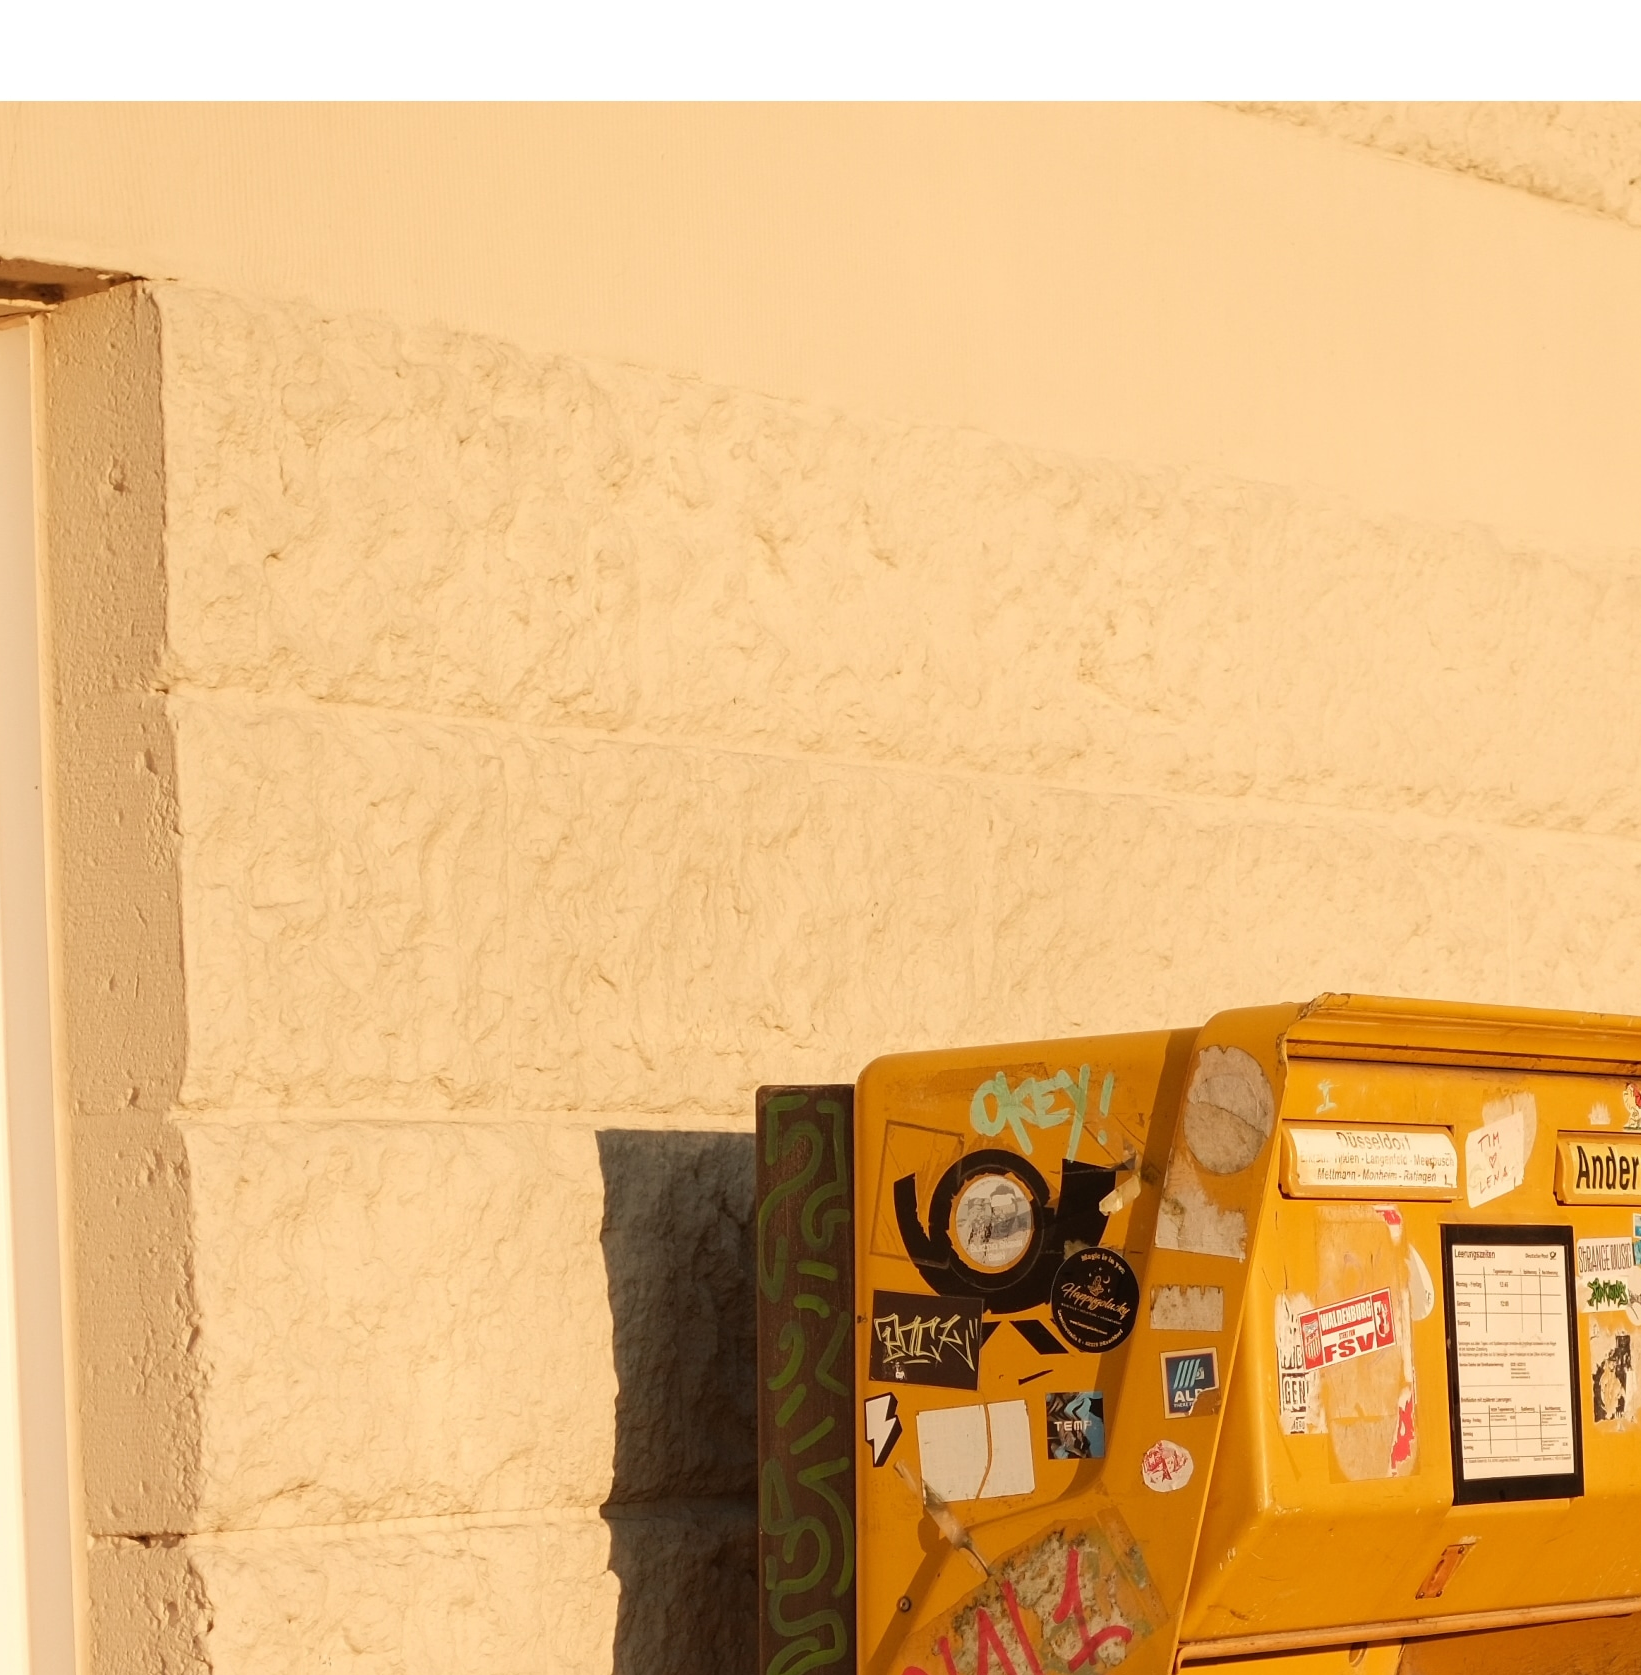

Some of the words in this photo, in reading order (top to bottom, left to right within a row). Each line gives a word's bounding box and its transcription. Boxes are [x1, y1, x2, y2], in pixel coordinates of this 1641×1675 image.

[1477, 1130, 1500, 1153] TIM
[1362, 1168, 1397, 1181] Monheim
[1320, 1300, 1372, 1331] WALDENBURG
[1323, 1332, 1375, 1363] FSV
